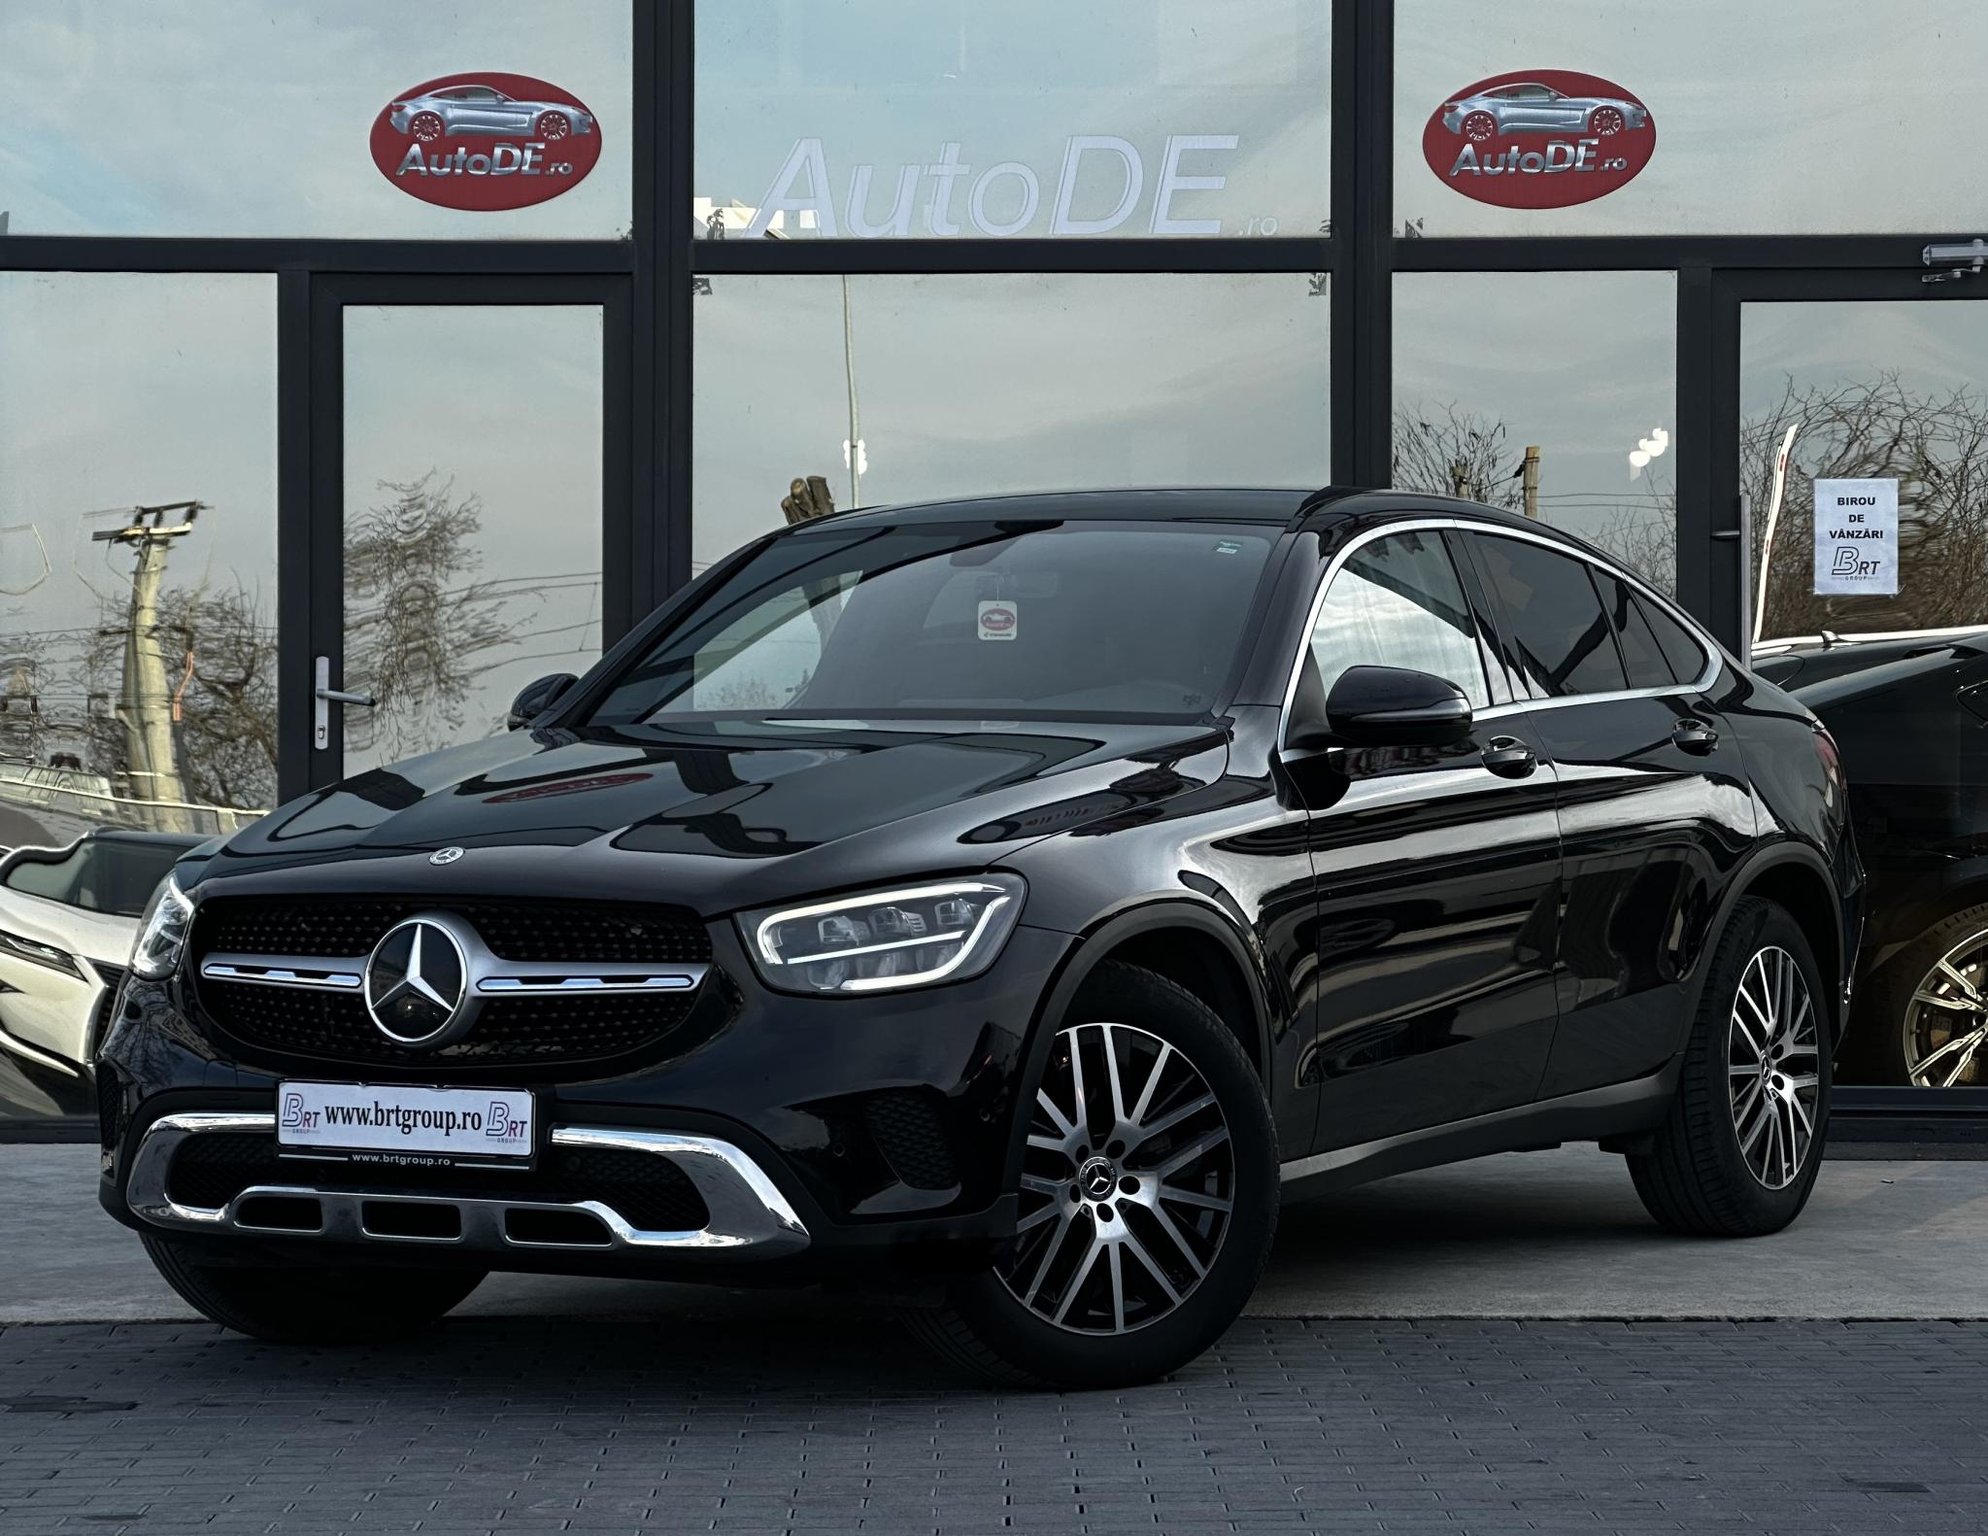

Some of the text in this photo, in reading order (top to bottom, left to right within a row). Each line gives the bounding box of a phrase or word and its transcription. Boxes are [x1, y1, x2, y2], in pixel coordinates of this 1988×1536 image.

[1837, 496, 1876, 506] BIROU
[1848, 514, 1865, 523] DE
[1829, 528, 1883, 539] VÂNZĂRI
[324, 1101, 482, 1136] www.brtgroup.ro
[352, 1153, 450, 1167] www.brtgroup.ro
